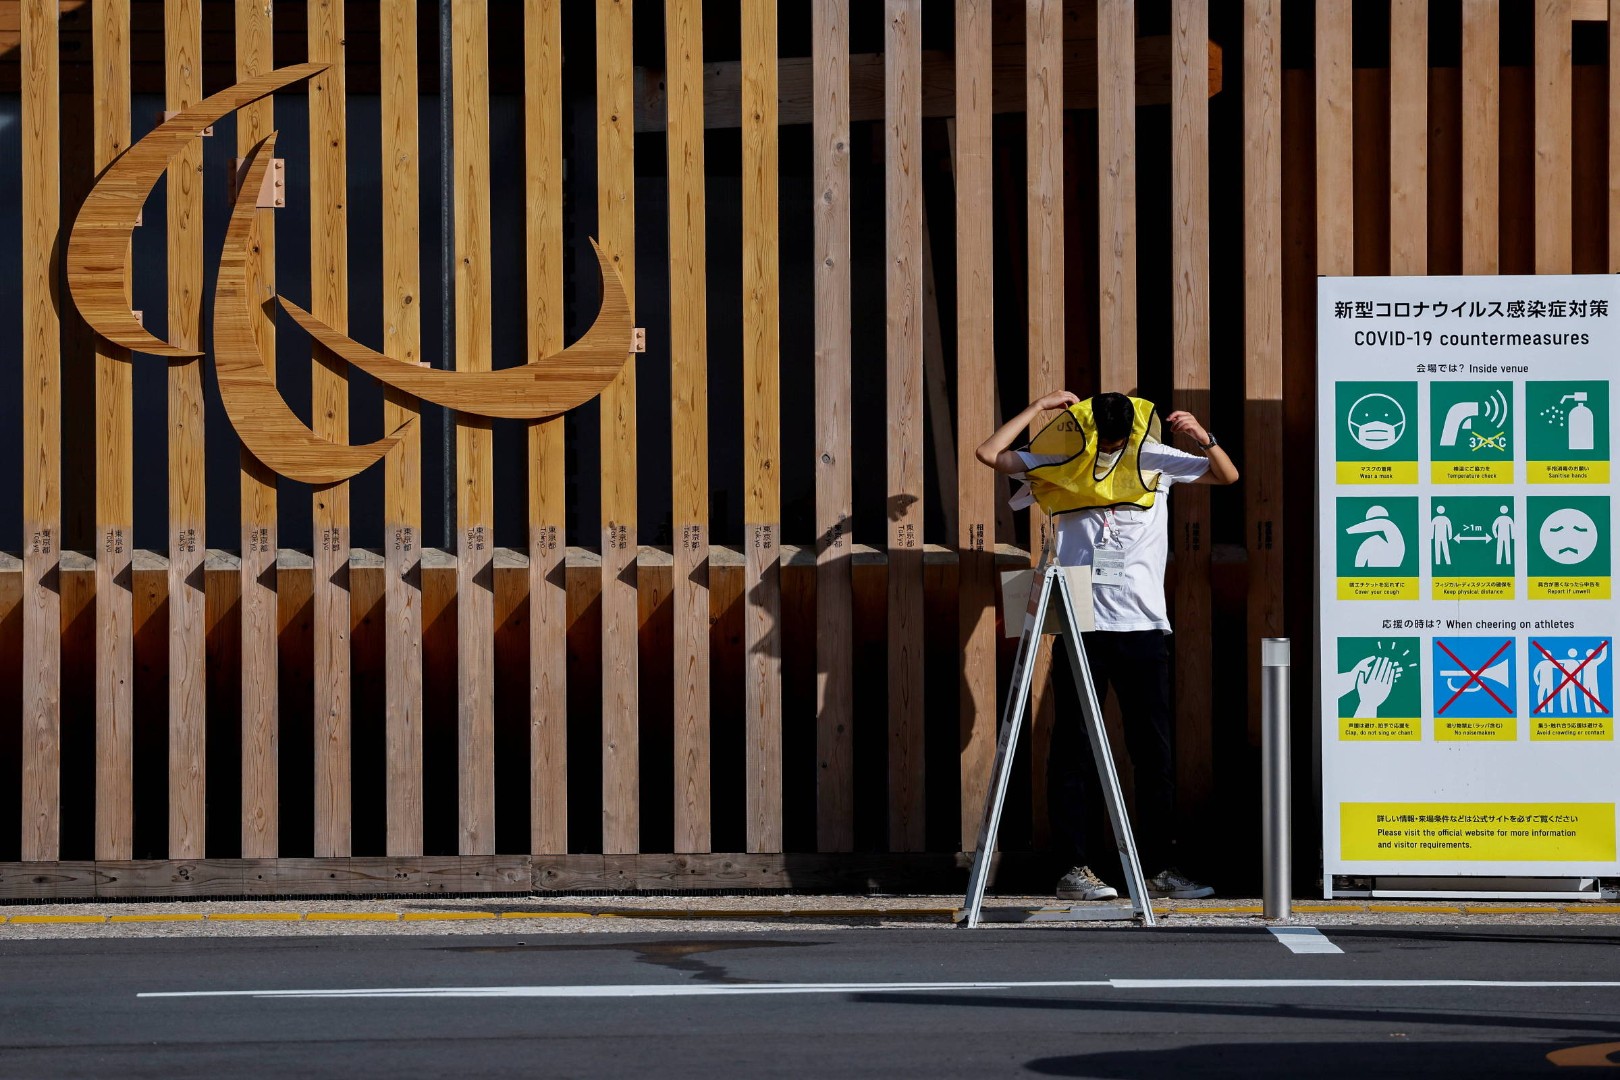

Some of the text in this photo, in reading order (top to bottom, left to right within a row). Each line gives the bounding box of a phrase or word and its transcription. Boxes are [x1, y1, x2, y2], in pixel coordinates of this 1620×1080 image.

[1334, 300, 1608, 319] 新型コロナウイルス感染症対策
[1355, 331, 1589, 346] COVID-19 countermeasures
[1469, 364, 1498, 373] Inside
[42, 529, 50, 553] 東京都
[115, 530, 123, 554] 東京都
[187, 529, 195, 552] 東京都
[476, 527, 484, 550] 東京都
[548, 526, 556, 549] 東京都
[763, 526, 771, 548] 東京都
[906, 524, 914, 547] 東京都
[1446, 620, 1472, 629] When
[1476, 620, 1516, 630] cheering
[1534, 620, 1574, 628] athletes
[1420, 841, 1472, 849] requirements.
